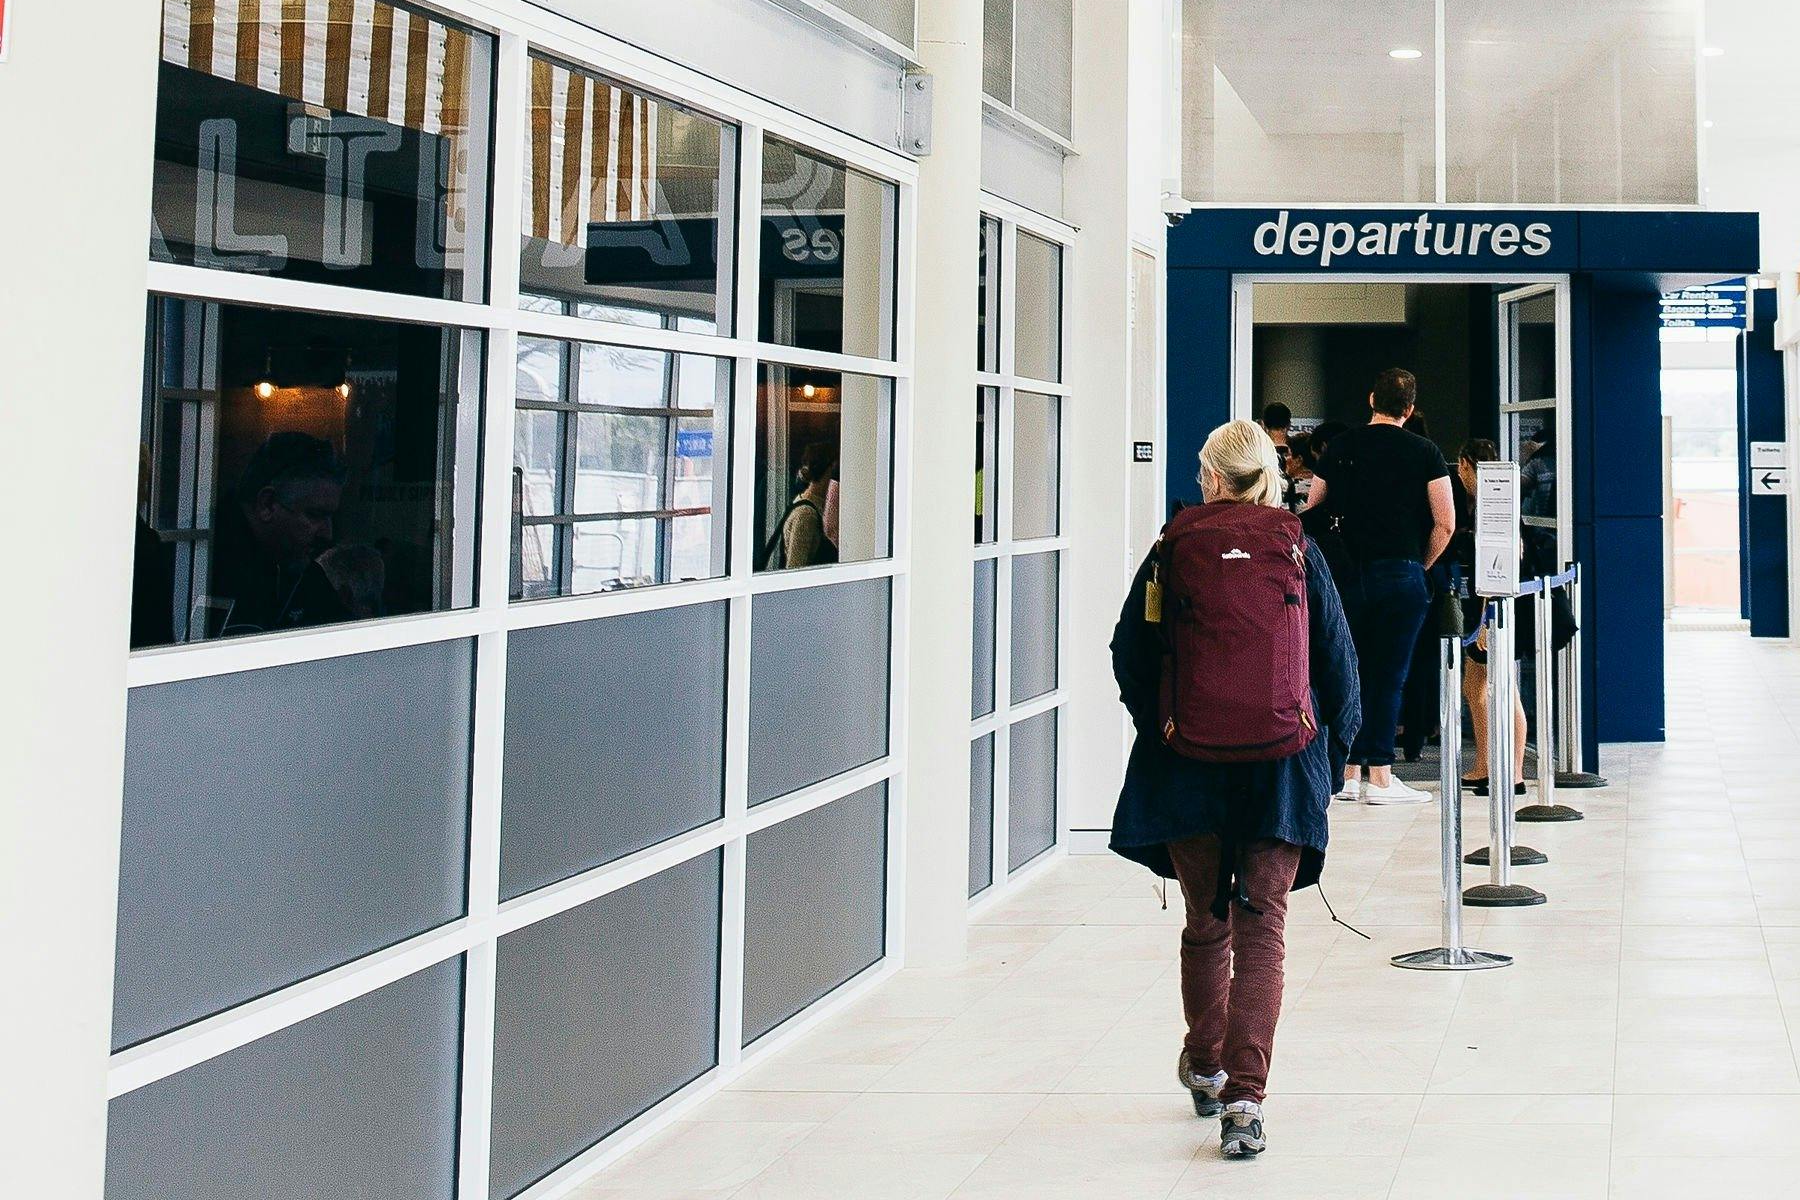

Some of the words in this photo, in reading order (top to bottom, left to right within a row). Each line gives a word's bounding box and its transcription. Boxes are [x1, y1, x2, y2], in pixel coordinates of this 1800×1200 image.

[1253, 210, 1552, 267] departures
[1681, 291, 1719, 300] Rentals
[1663, 319, 1695, 327] Toilets
